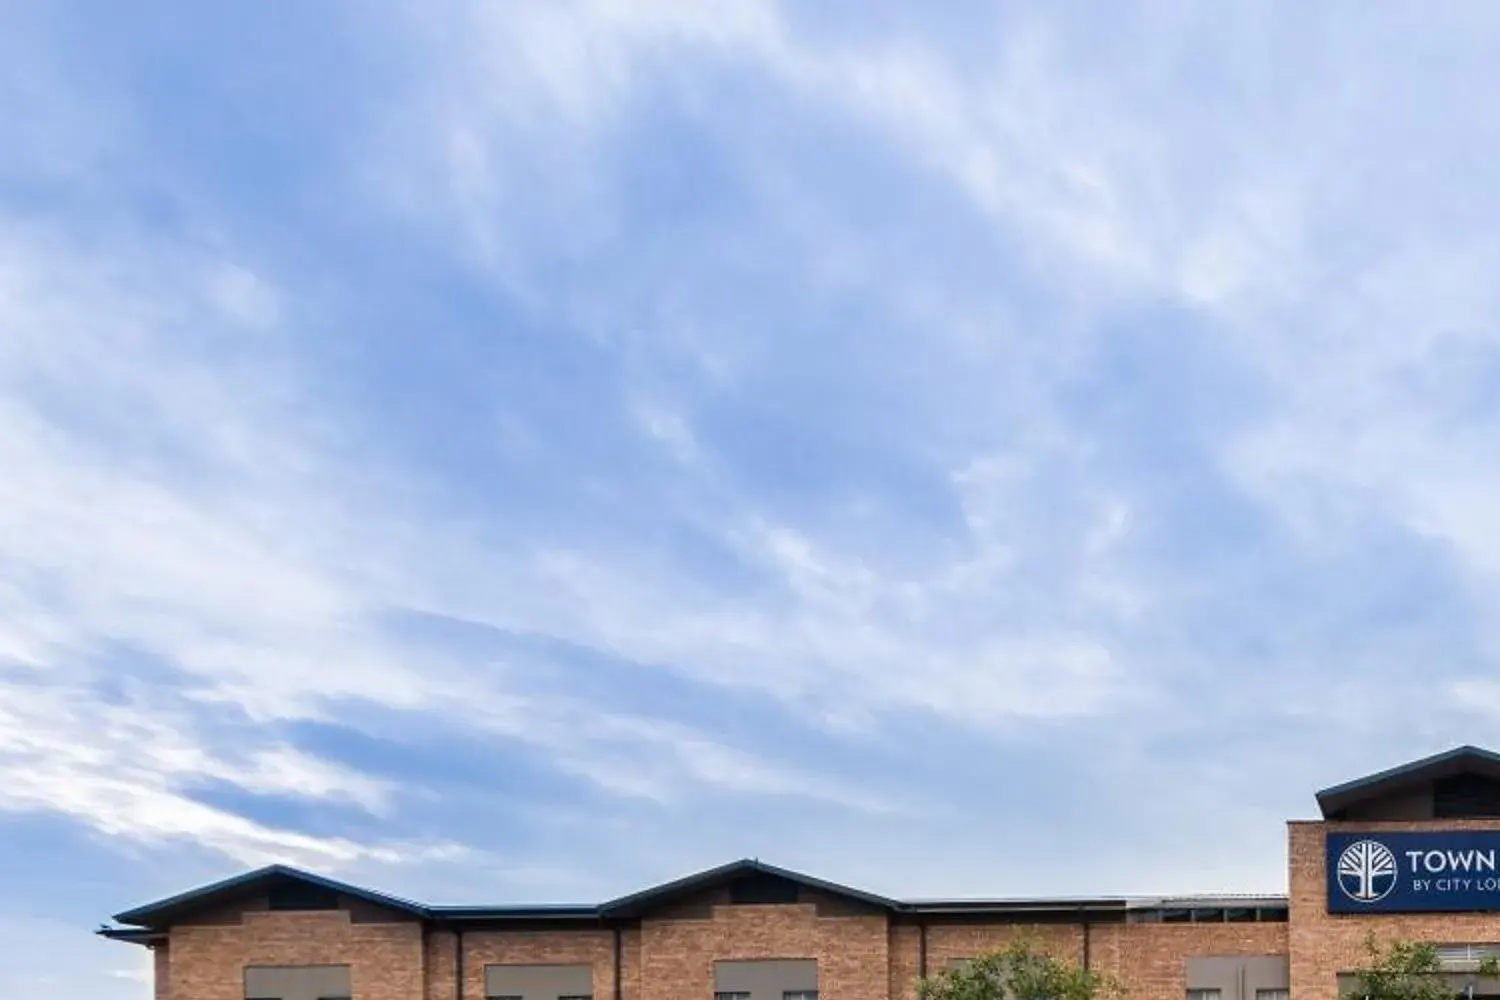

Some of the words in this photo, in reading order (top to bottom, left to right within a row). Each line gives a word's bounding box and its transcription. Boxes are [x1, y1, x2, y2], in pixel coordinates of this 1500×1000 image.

[1405, 850, 1495, 872] TOWN
[1413, 879, 1430, 891] BY
[1436, 878, 1471, 891] CITY
